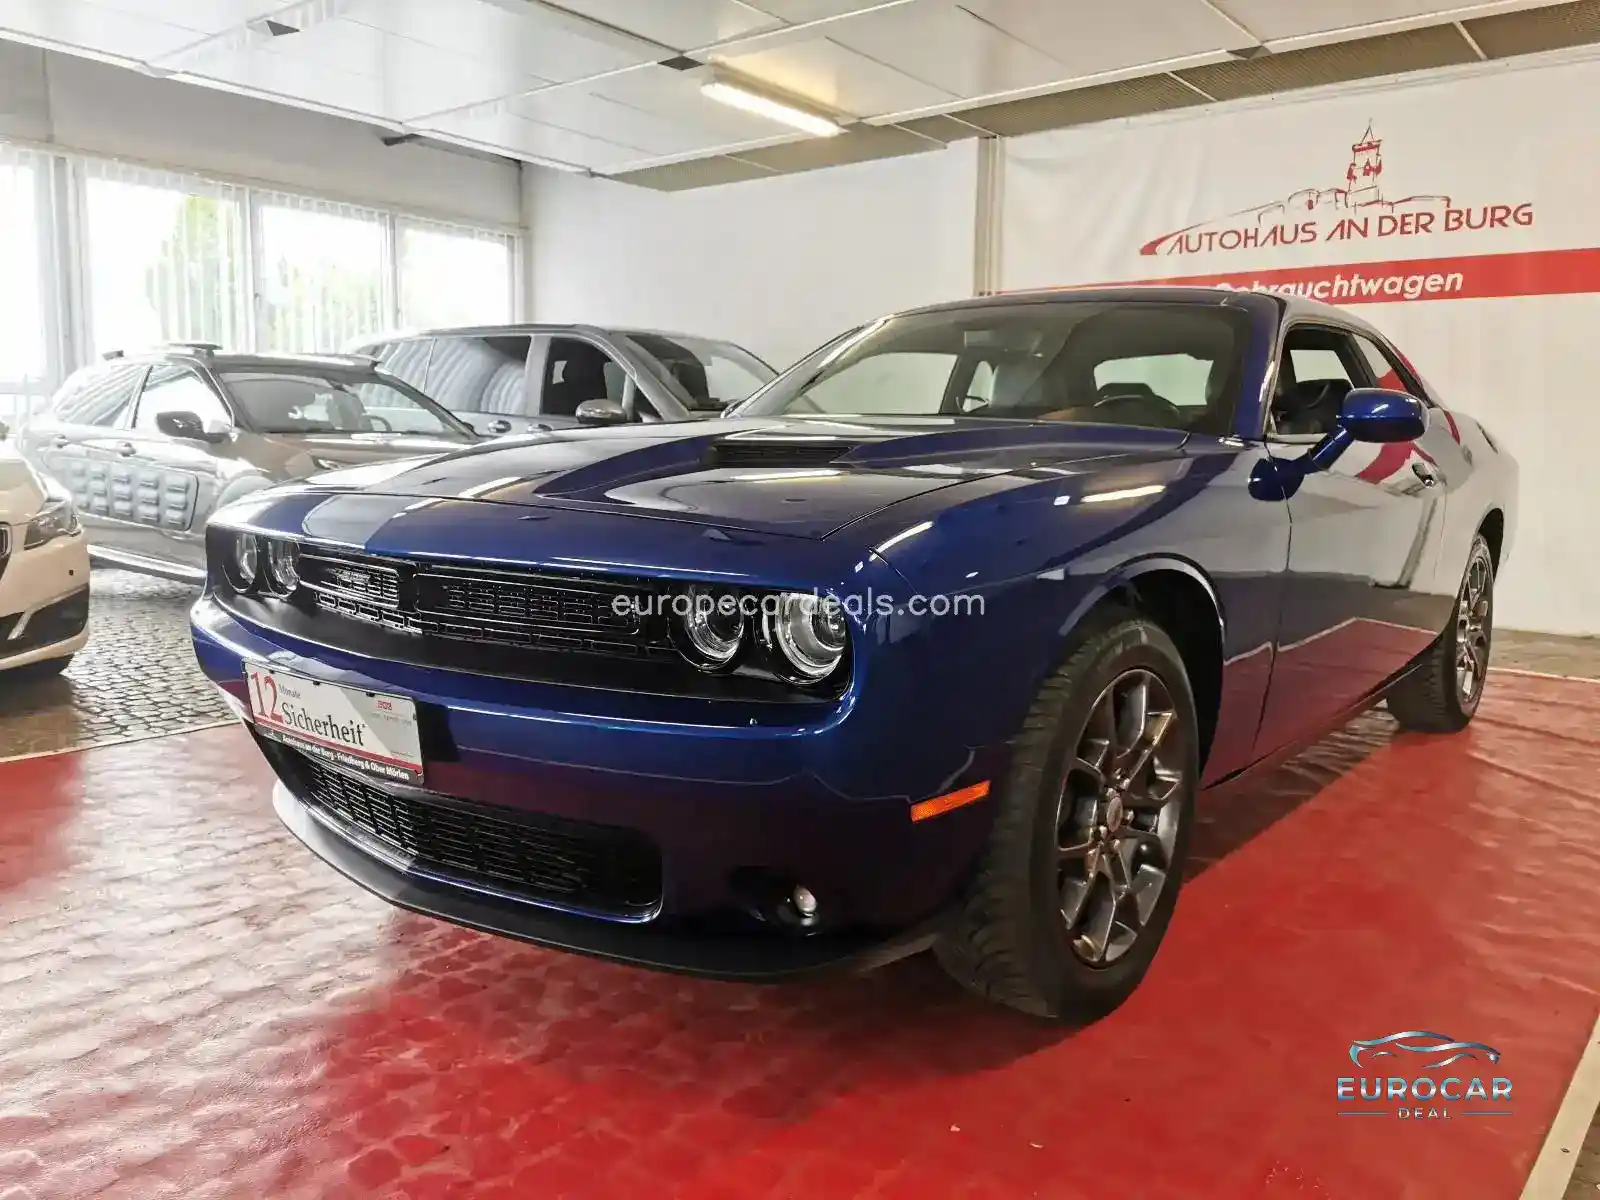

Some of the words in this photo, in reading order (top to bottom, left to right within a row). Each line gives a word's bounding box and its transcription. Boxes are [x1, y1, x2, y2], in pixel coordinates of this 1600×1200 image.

[1167, 220, 1318, 254] AUTOHAUS
[1326, 214, 1369, 242] AN
[1377, 211, 1436, 238] DER
[1444, 203, 1533, 232] BURG
[1217, 271, 1464, 300] brauchtwagen
[251, 672, 284, 724] 12
[371, 762, 386, 775] Ober
